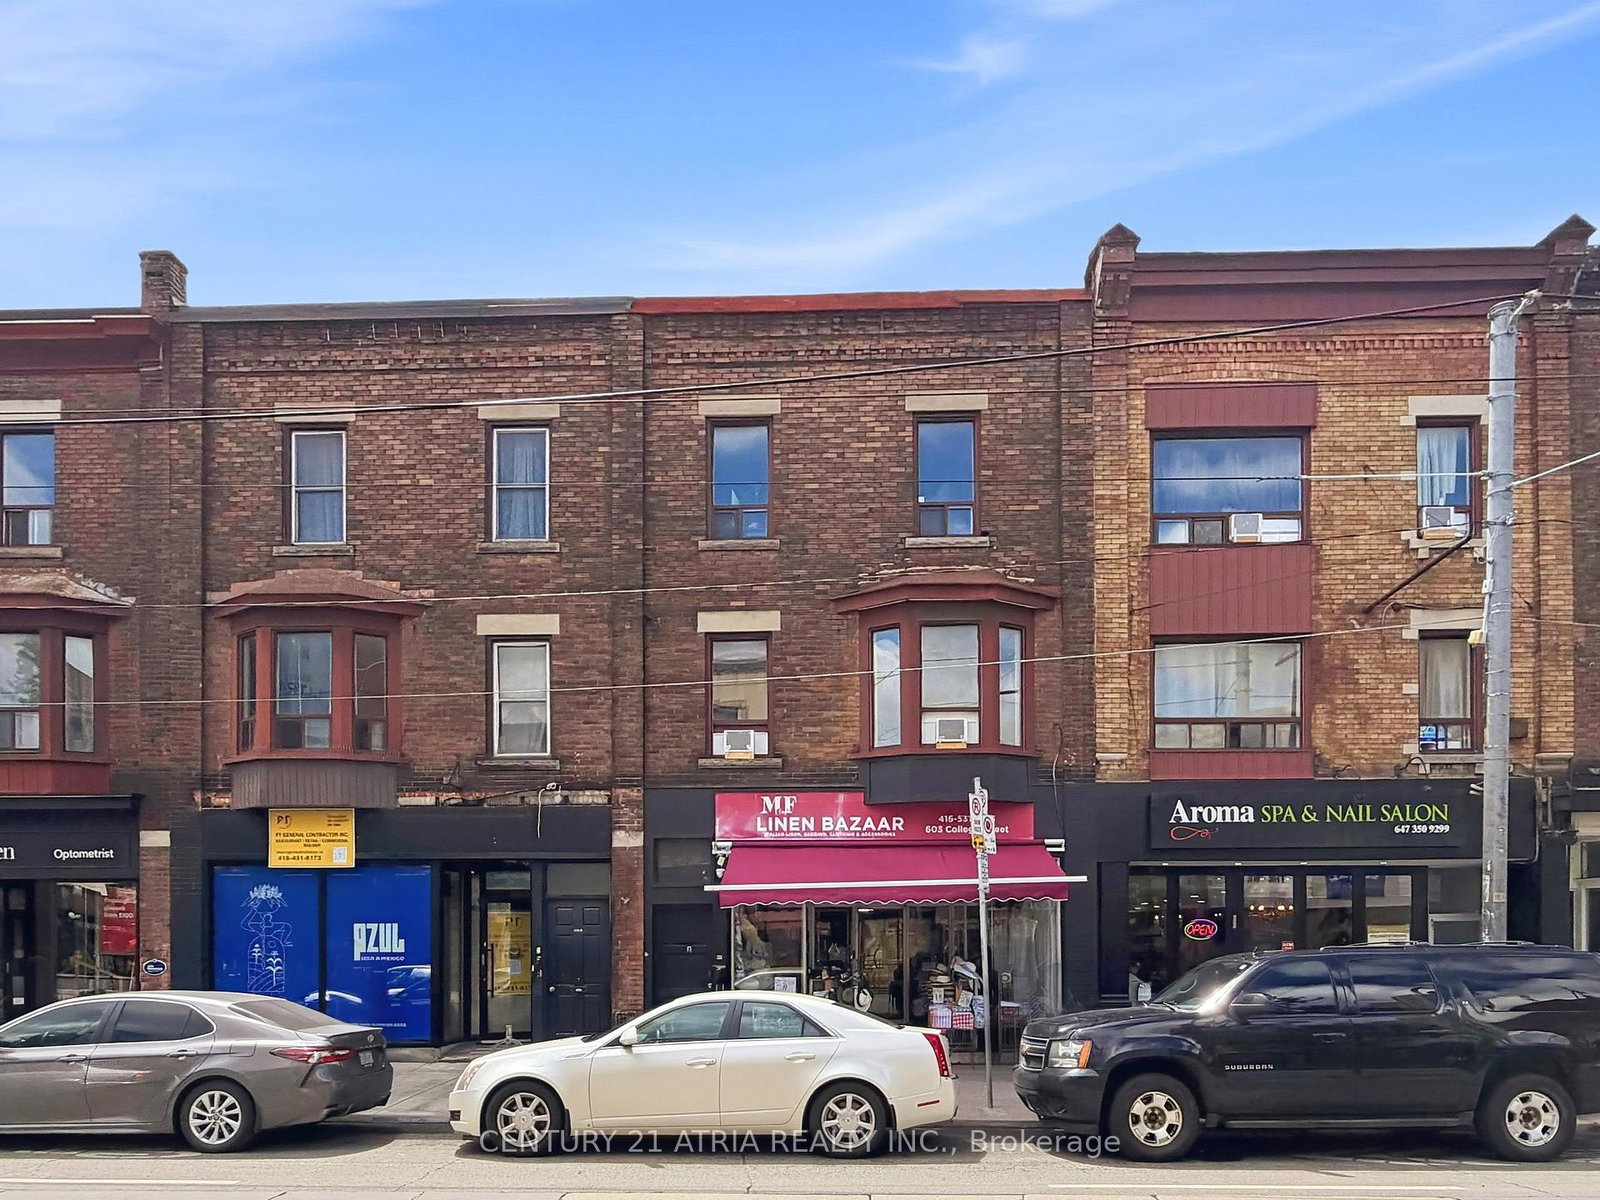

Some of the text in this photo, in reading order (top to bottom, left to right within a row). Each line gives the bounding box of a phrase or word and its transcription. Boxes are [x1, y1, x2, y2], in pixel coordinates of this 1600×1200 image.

[1169, 799, 1449, 823] Aroma SPA & NAIL SALON
[756, 817, 905, 831] LINEN BAZAAR
[945, 825, 973, 834] Colle
[1394, 825, 1450, 833] 647 350 9299
[53, 849, 114, 860] Optometrist
[1186, 923, 1215, 936] OPEN
[353, 923, 405, 961] AZUL
